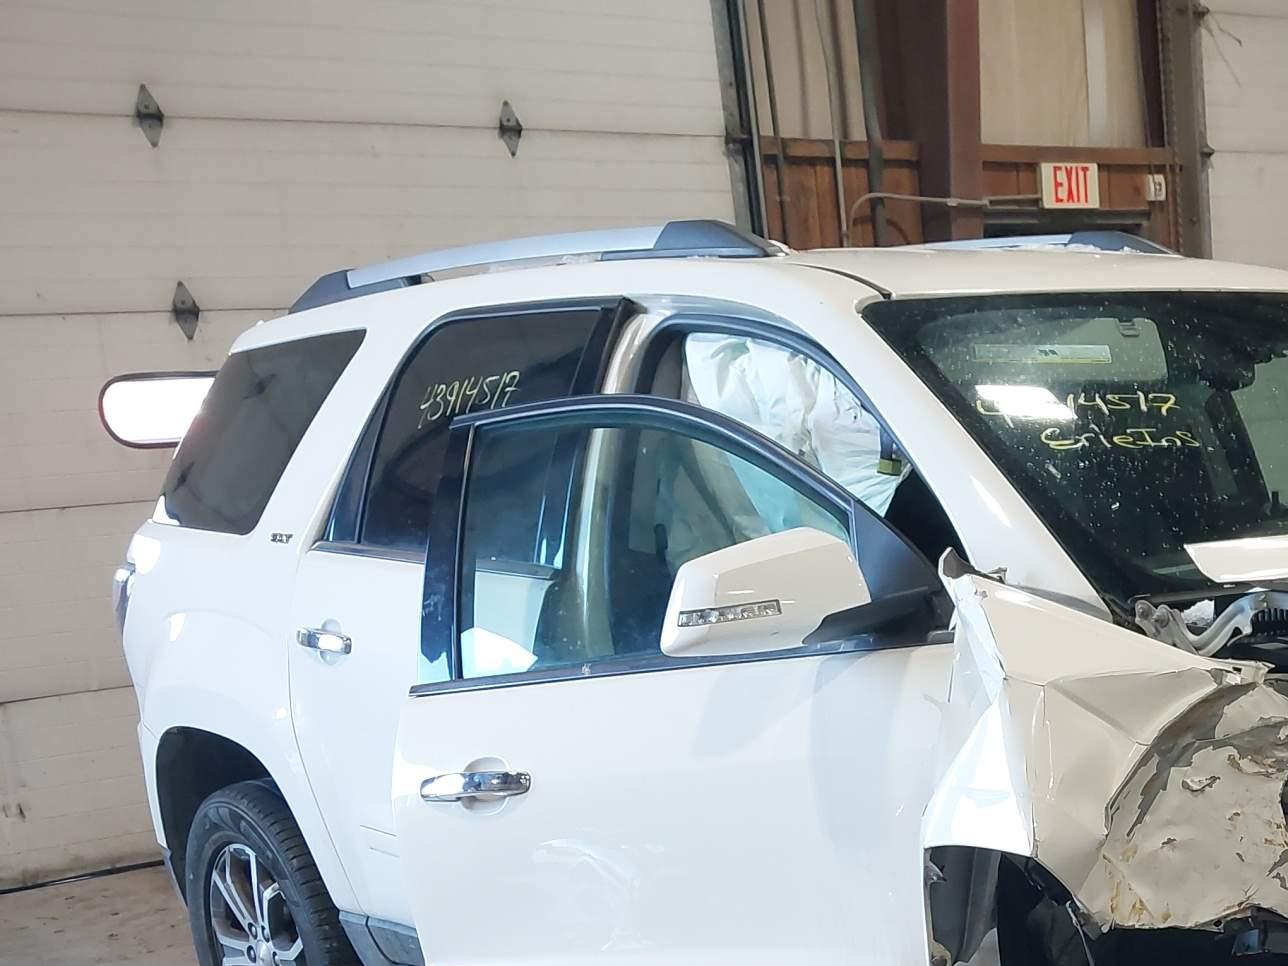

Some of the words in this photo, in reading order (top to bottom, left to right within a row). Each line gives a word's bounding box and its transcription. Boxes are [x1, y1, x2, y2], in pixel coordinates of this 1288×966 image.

[1053, 166, 1089, 203] EXIT
[418, 371, 520, 429] 43914517
[977, 391, 1180, 428] 414517
